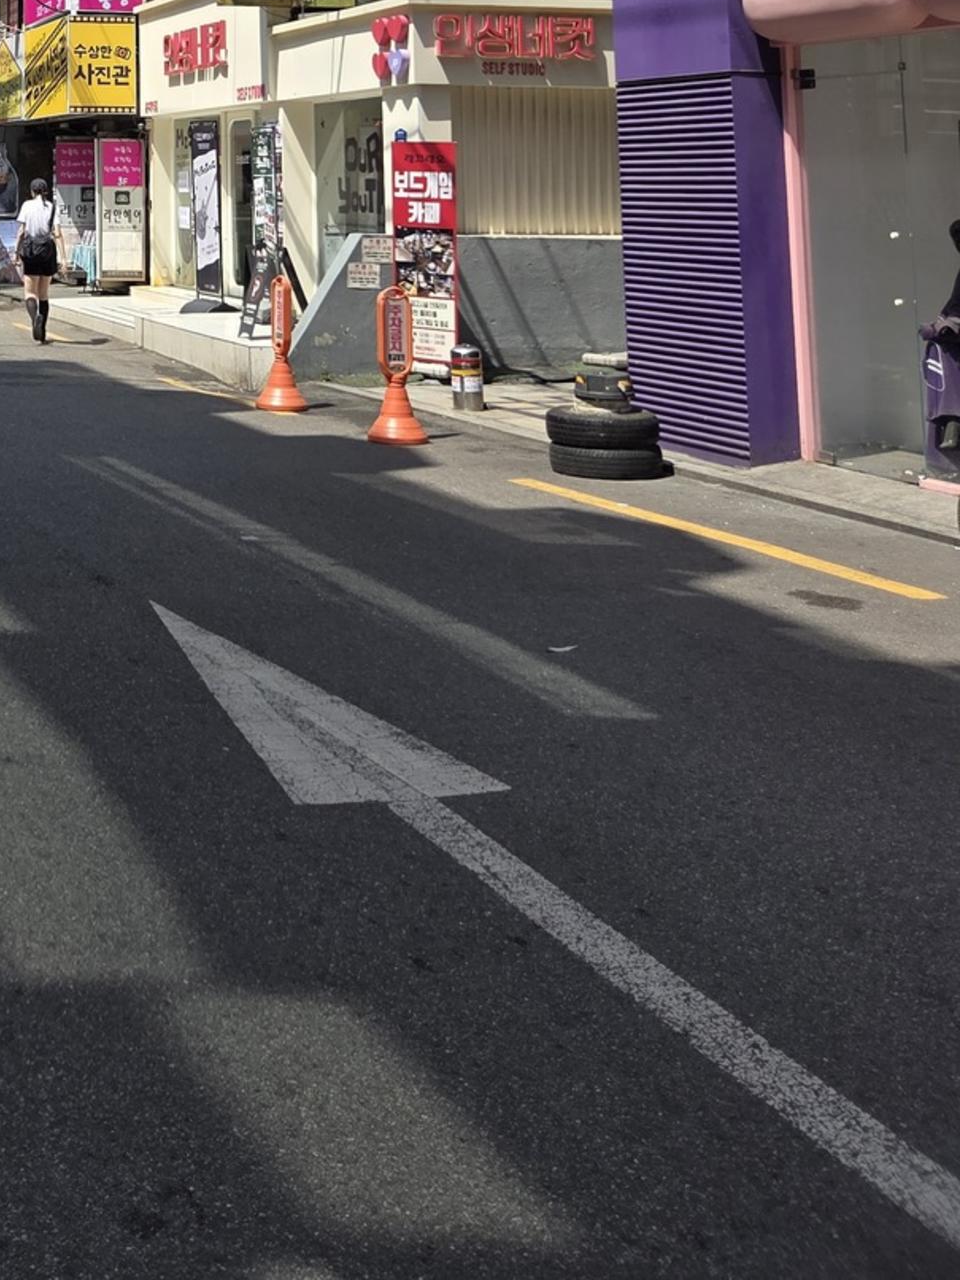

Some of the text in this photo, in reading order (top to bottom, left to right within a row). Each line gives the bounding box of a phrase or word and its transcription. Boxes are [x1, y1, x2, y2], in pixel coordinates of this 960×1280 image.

[433, 13, 598, 61] 인생네컷
[73, 44, 112, 60] 수상한
[73, 63, 132, 87] 사진관
[481, 61, 546, 77] SELF STUDIO
[394, 170, 453, 200] 보드게임
[103, 208, 142, 225] 리안헤어
[408, 201, 441, 224] 카페
[388, 305, 402, 352] 주차금지
